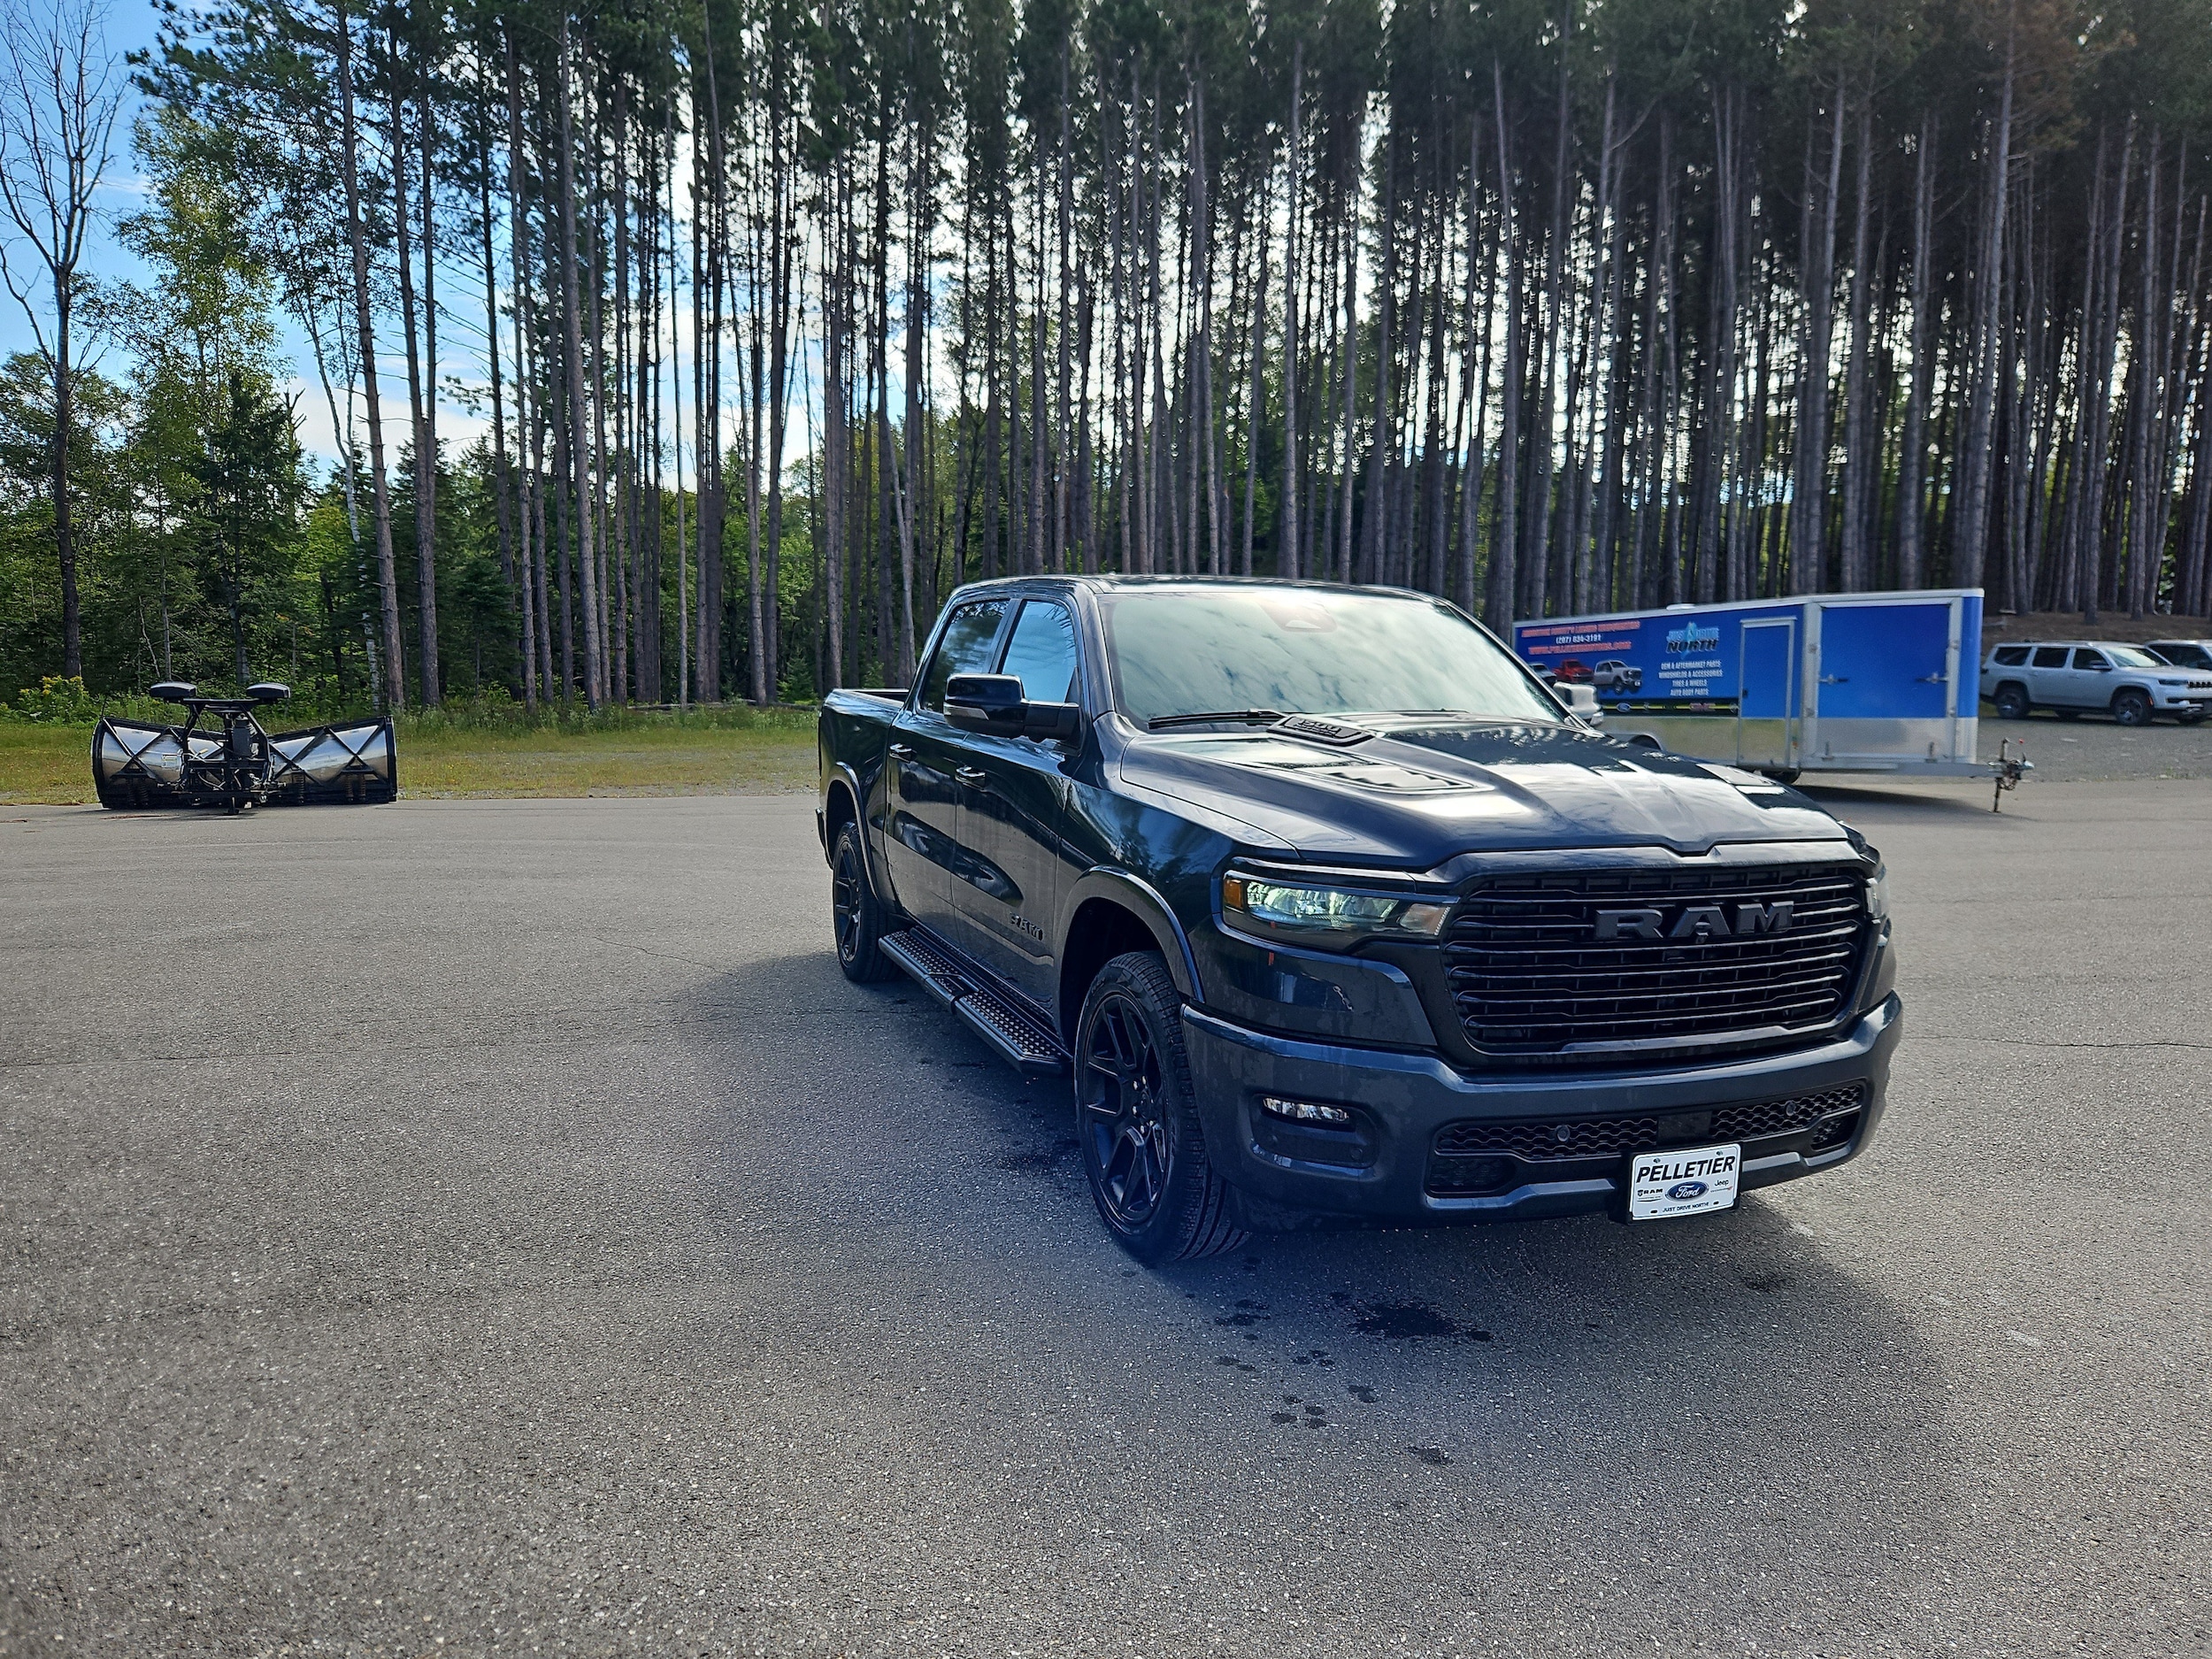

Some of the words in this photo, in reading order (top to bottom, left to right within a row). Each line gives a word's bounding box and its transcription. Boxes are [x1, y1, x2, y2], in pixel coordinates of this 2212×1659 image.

[1666, 639, 1718, 654] NORTH
[1675, 660, 1706, 669] AFTERMARKET
[1706, 658, 1721, 668] PARTS
[1595, 901, 1794, 939] RAM
[1636, 1156, 1735, 1183] PELLETIER
[1675, 1185, 1701, 1199] Ford
